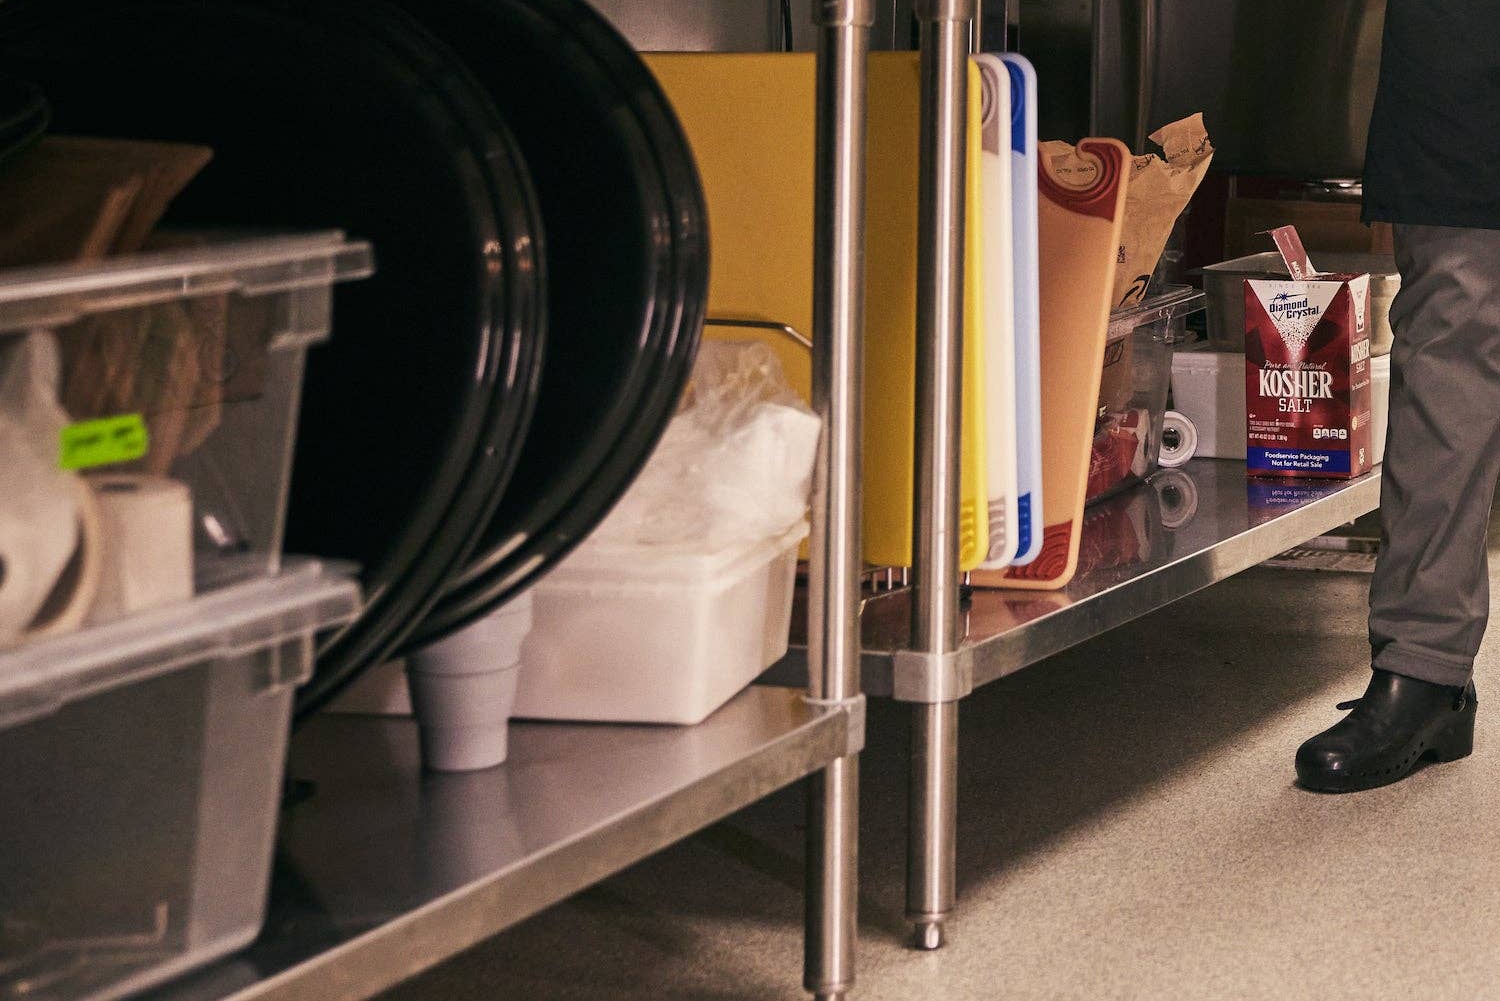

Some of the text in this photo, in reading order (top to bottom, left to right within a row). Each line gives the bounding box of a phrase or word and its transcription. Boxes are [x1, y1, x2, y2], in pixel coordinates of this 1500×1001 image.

[1269, 298, 1308, 313] Diamond
[1286, 306, 1320, 319] Crystal
[1264, 360, 1281, 369] Pure
[1259, 369, 1334, 399] KOSHER
[1278, 398, 1312, 413] SALT
[1265, 451, 1329, 461] Foodservice Packaging
